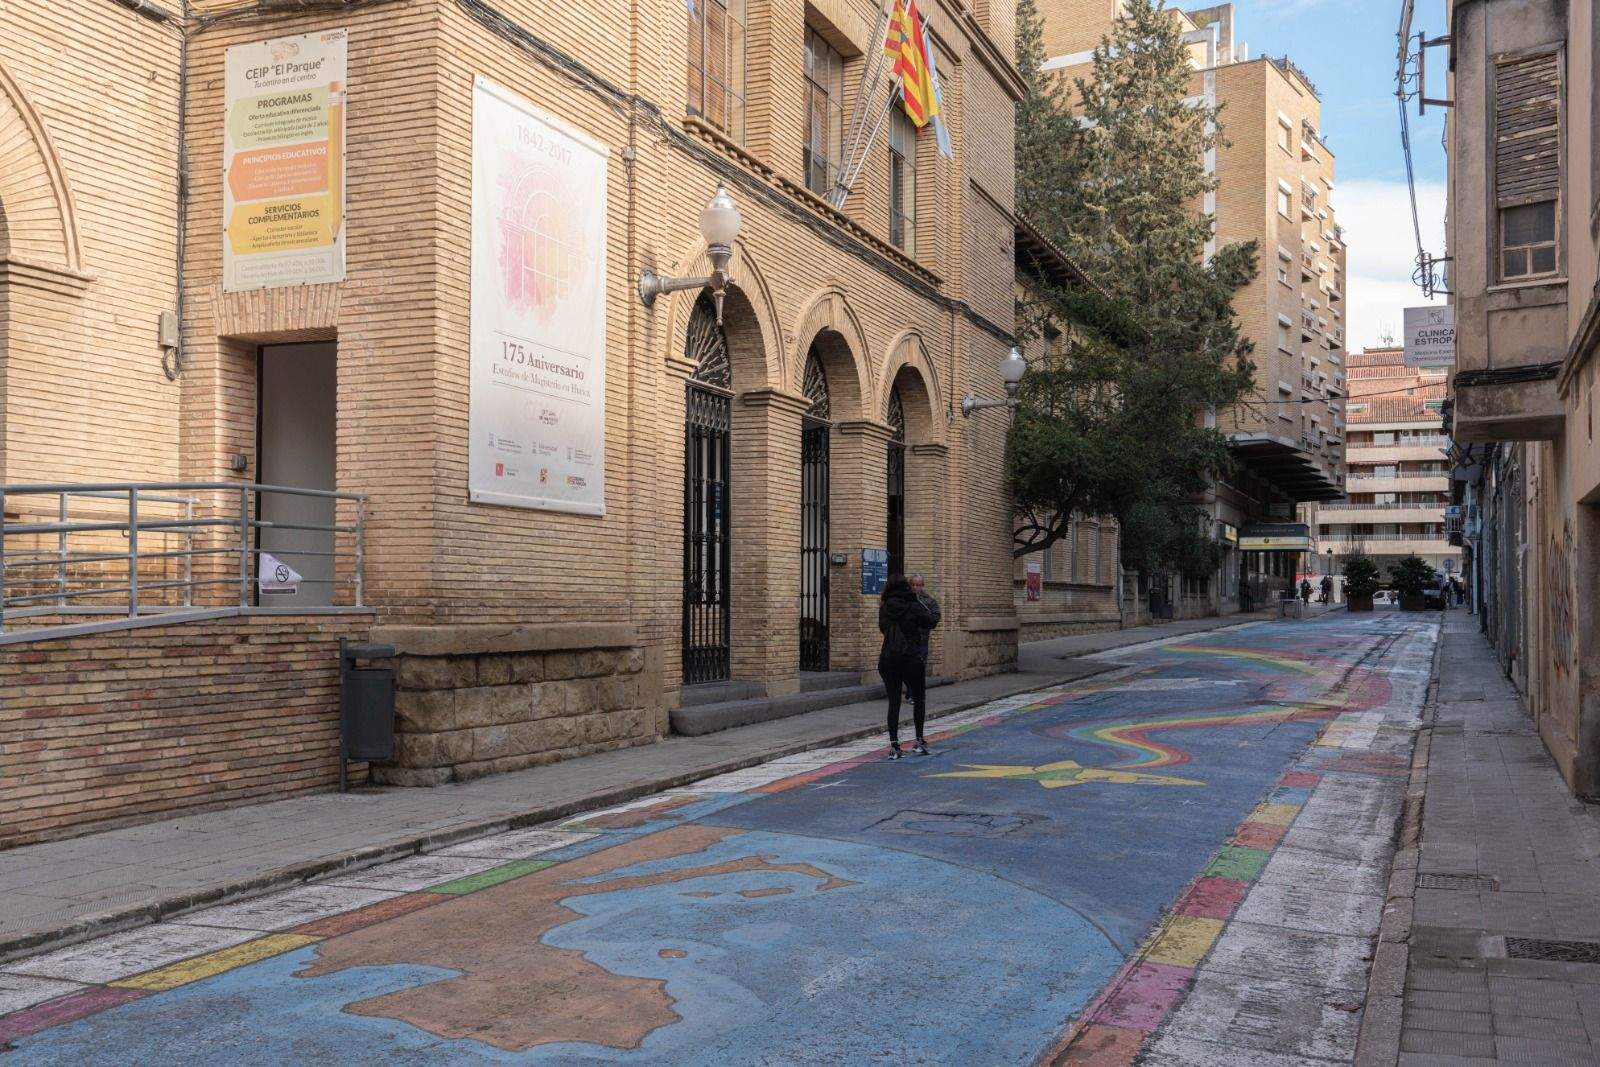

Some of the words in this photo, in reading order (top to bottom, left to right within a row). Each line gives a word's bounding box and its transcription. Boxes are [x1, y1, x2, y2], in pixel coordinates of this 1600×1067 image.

[246, 66, 269, 80] CEIP
[297, 73, 317, 82] centro
[257, 93, 313, 109] PROGRAMAS
[516, 125, 572, 166] 1842-2017
[243, 151, 281, 165] PRINCIPIOS
[282, 146, 327, 159] EDUCATIVOS
[264, 203, 302, 214] SERVICIOS
[248, 209, 320, 225] COMPLEMENTARIOS
[1415, 337, 1456, 345] ESTROP
[502, 341, 525, 365] 175
[527, 352, 585, 381] Aniversario
